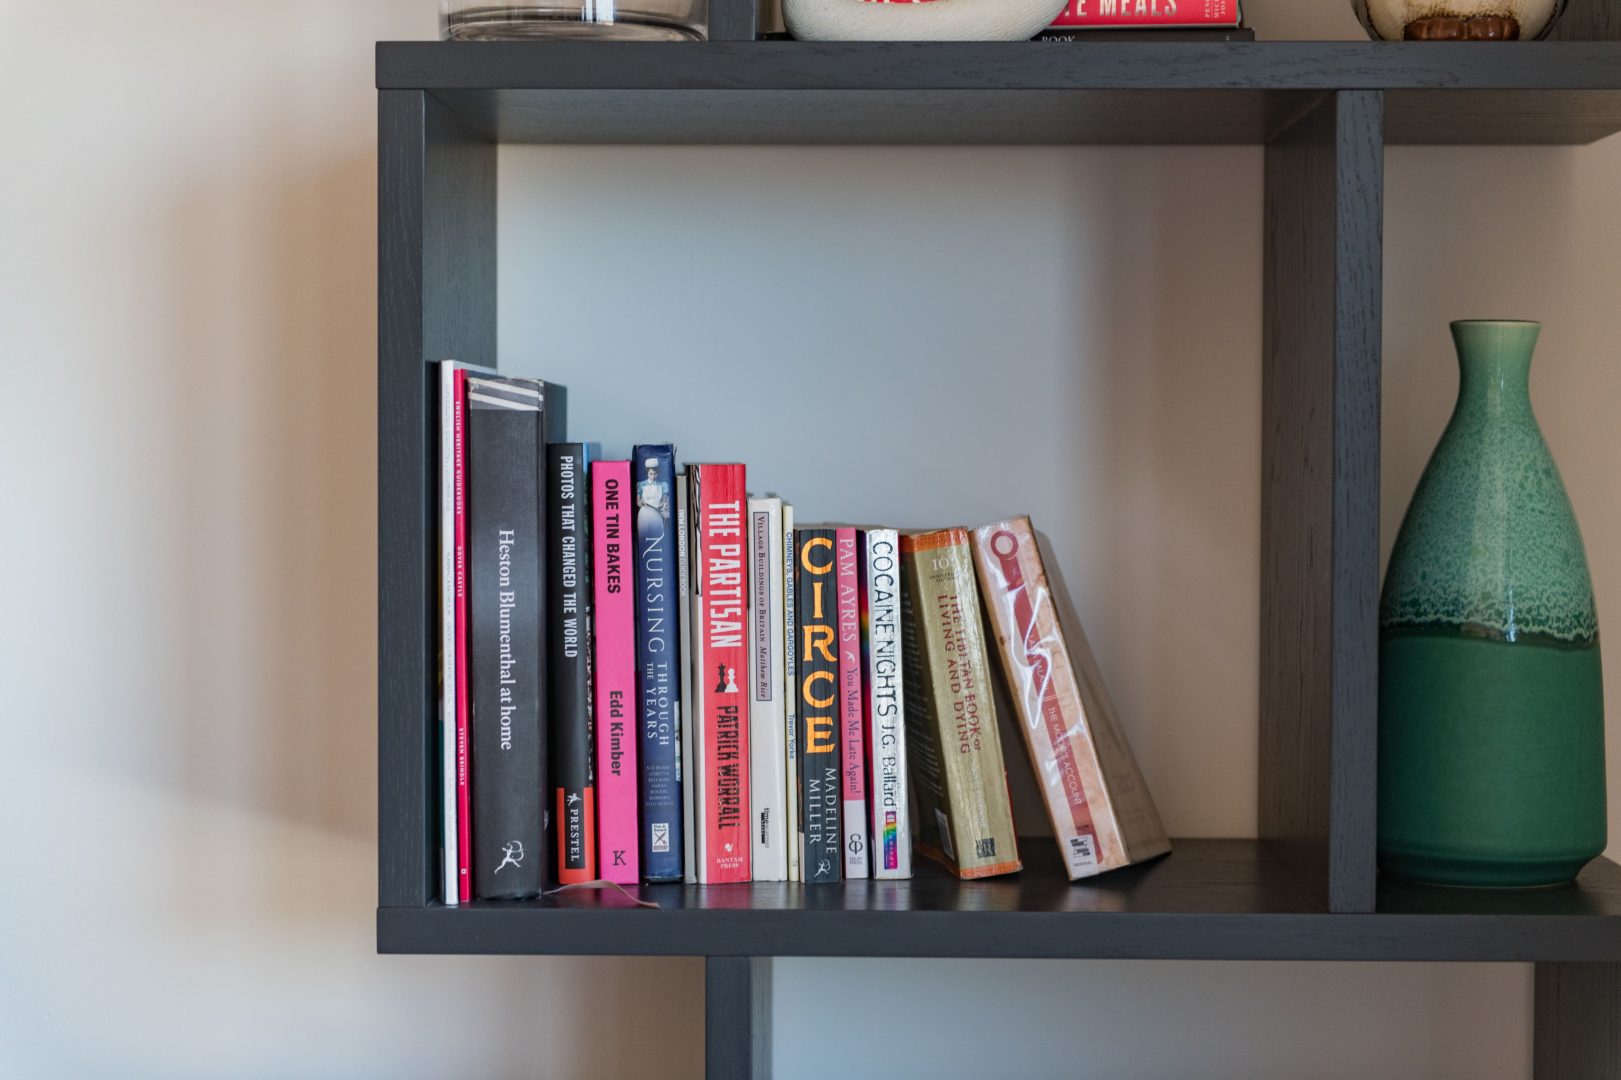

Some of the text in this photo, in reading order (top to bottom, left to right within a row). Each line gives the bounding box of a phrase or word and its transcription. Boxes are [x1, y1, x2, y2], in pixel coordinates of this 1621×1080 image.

[560, 456, 578, 657] PHOTOS THAT CHANGED THE WORLD
[605, 479, 621, 594] ONE TIN BAKES
[708, 500, 742, 648] THE PARTISAN
[785, 531, 793, 575] CHIMNEYS,
[643, 532, 665, 653] NURSING
[786, 610, 794, 627] AND
[839, 538, 856, 642] PAM AYRES
[873, 541, 898, 717] COCAINE NIGHTS
[938, 595, 956, 652] LIVING
[499, 530, 517, 750] Heston Blumenthal at home
[760, 646, 768, 679] Matthew
[787, 629, 795, 676] GARGOYLES
[801, 537, 838, 754] CIRCE
[948, 660, 961, 694] AND
[950, 595, 961, 623] THE
[965, 694, 981, 738] BOOK
[646, 662, 657, 739] THE YEARS
[657, 662, 669, 745] THROUGH
[760, 681, 768, 698] Rice
[846, 667, 861, 794] You Made Me Late Again!
[954, 701, 970, 754] DYING
[610, 690, 625, 776] Edd Kimber
[716, 705, 741, 830] PATRICK WORRALL
[881, 725, 897, 807] J.G. Ballard
[1047, 706, 1058, 722] THE
[1064, 760, 1083, 805] ACCOUNT
[570, 808, 580, 861] PRESTEL
[809, 779, 822, 845] MILLER
[825, 767, 837, 854] MADELINE
[613, 850, 626, 866] K
[716, 856, 743, 864] BANTAM
